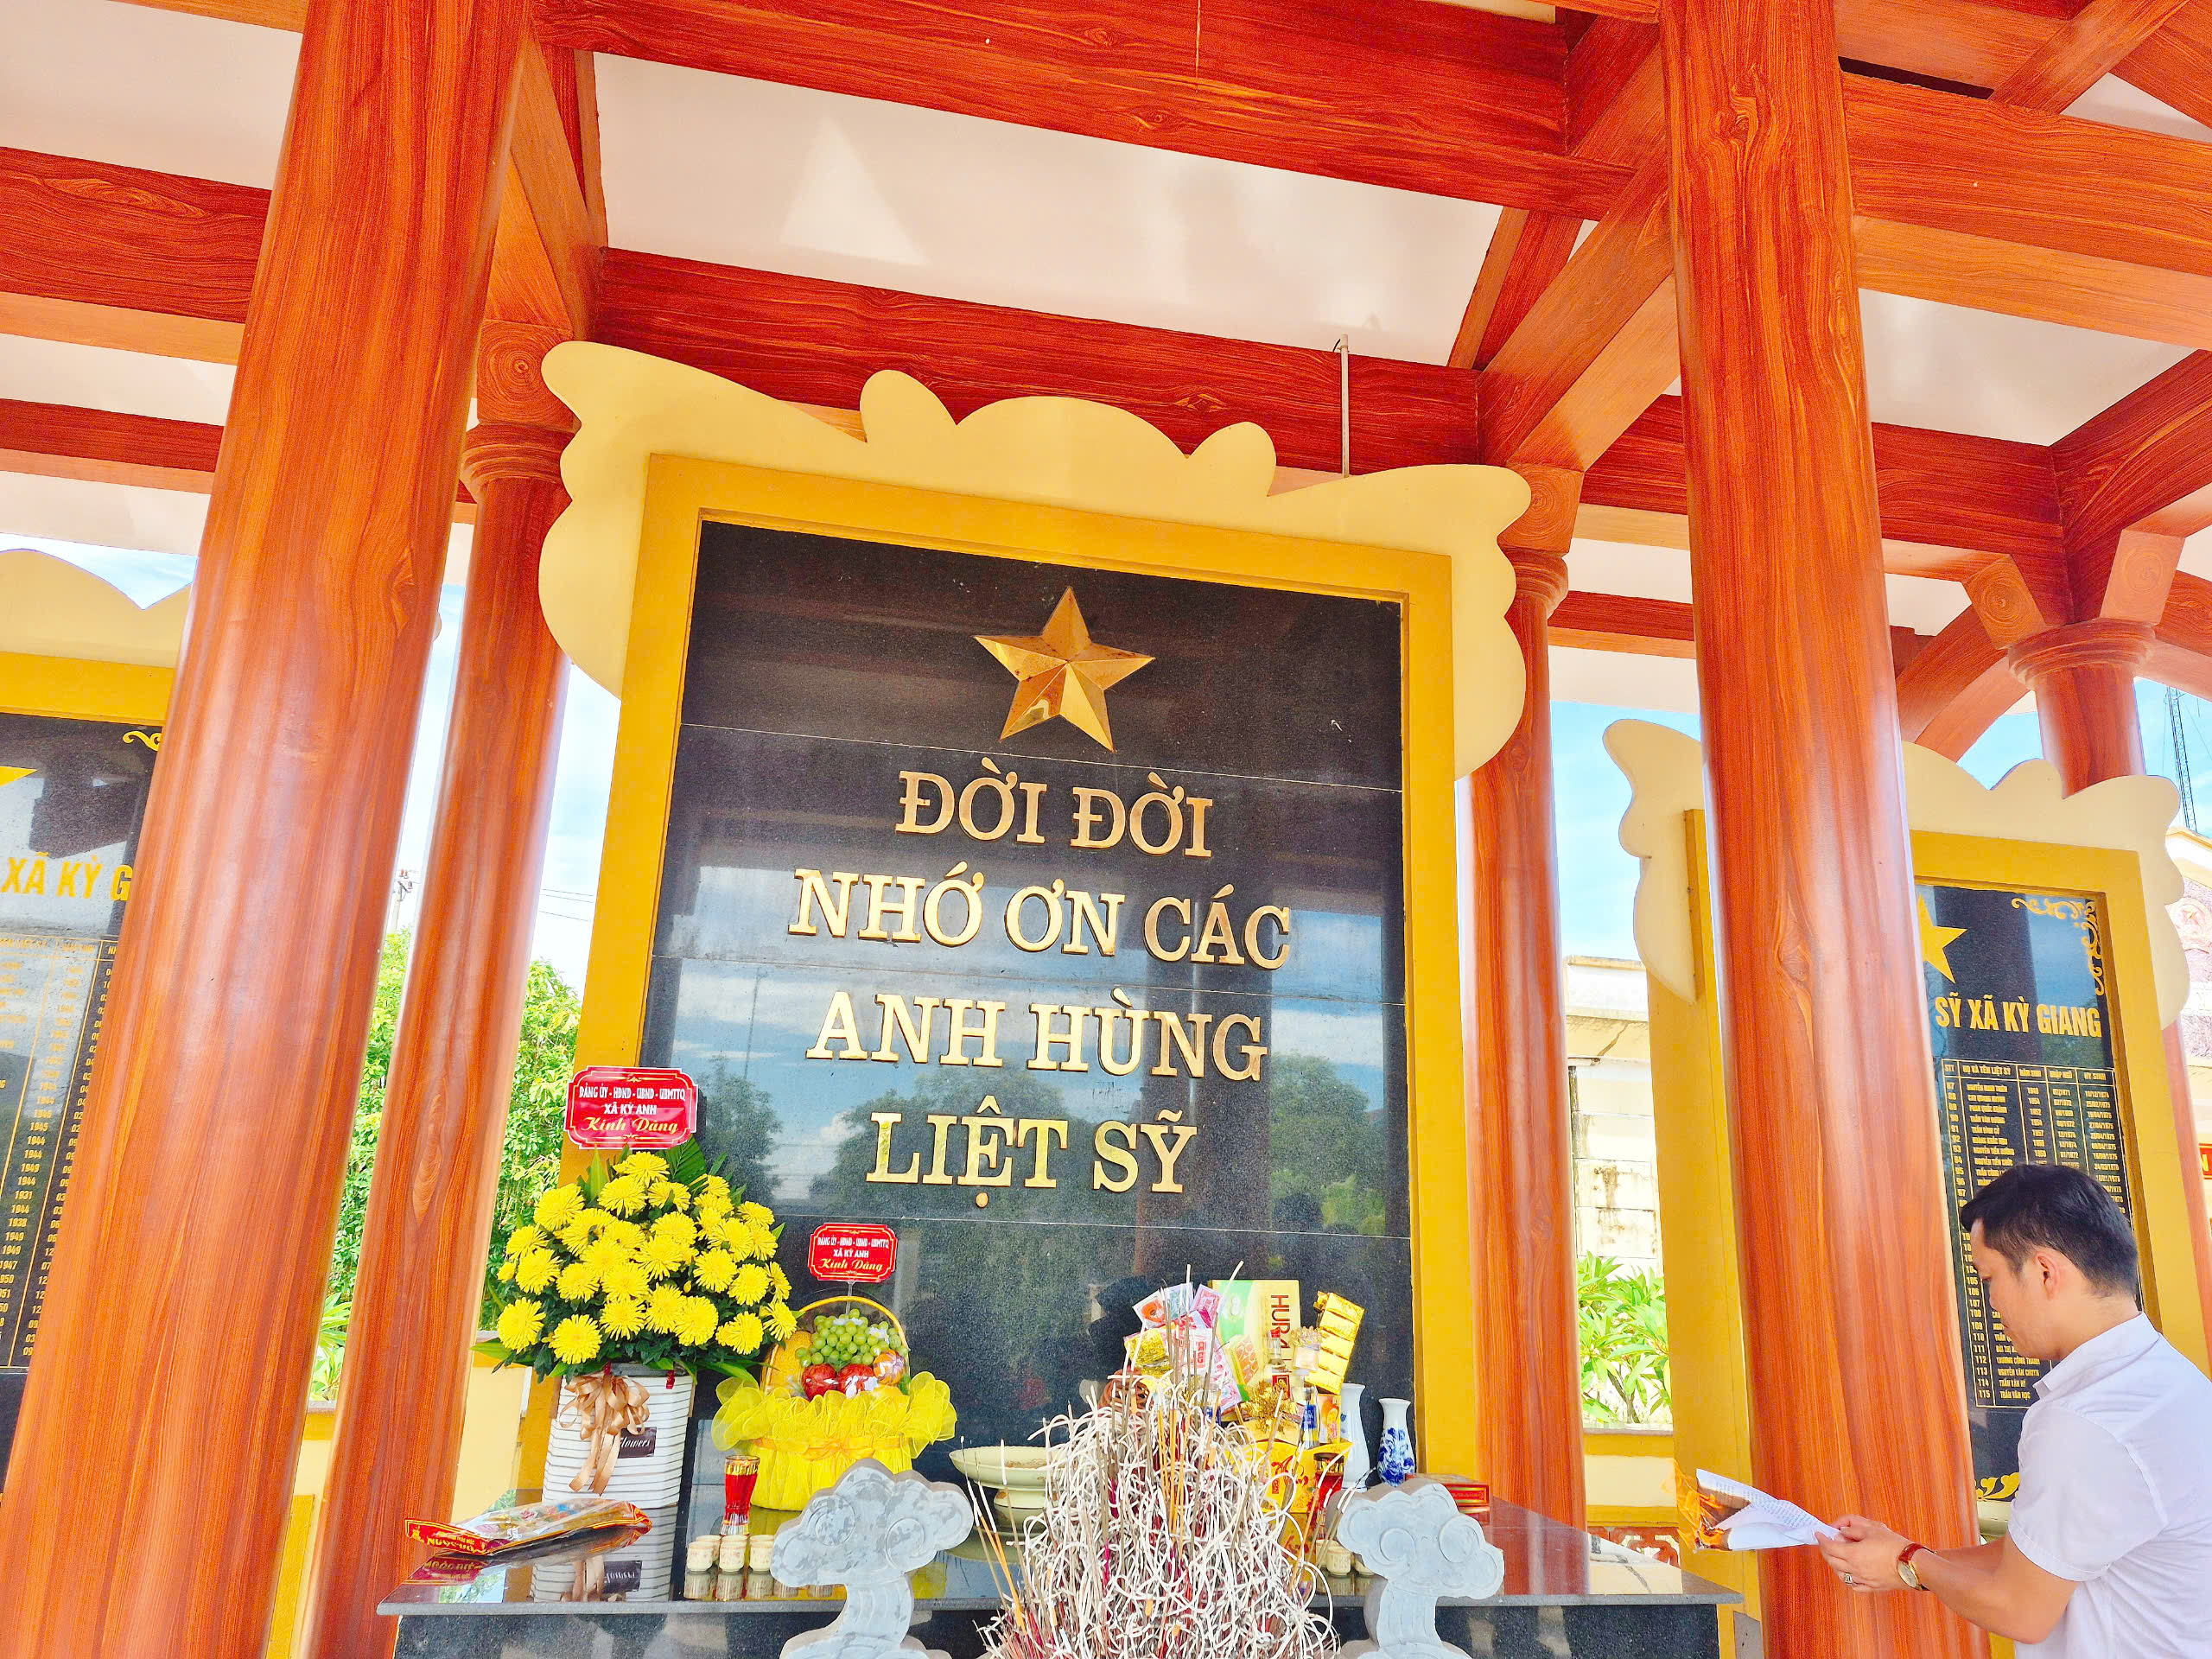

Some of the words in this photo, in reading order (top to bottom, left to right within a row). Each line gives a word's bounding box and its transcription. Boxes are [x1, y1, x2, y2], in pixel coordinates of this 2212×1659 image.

[894, 756, 1048, 845] ĐỜI
[1069, 771, 1214, 859] ĐỜI
[0, 851, 49, 895] XÃ
[787, 861, 985, 949] NHỚ
[1003, 878, 1126, 957] ƠN
[1143, 883, 1291, 971] CÁC
[1935, 991, 1961, 1028] SỸ
[1967, 995, 1999, 1031] XÃ
[2003, 995, 2029, 1033] KỲ
[2036, 1003, 2102, 1038] GIANG
[805, 991, 1007, 1068] ANH
[1027, 987, 1269, 1083] HÙNG
[579, 1082, 598, 1098] ĐẢNG
[613, 1086, 632, 1099] HĐND
[636, 1087, 654, 1100] UBND
[604, 1101, 619, 1115] XÃ
[635, 1103, 658, 1116] ANH
[865, 1094, 1069, 1210] LIỆT
[1092, 1109, 1198, 1196] SỸ
[854, 1249, 869, 1258] ANH
[1967, 1276, 1978, 1285] 105
[1969, 1299, 1980, 1307] 107
[1973, 1332, 1985, 1341] 110
[1974, 1344, 1985, 1353] 111
[1974, 1356, 1987, 1364] 112
[1976, 1367, 1988, 1376] 113
[1977, 1378, 1989, 1387] 114
[1979, 1389, 1991, 1399] 115
[620, 1436, 651, 1448] lowers
